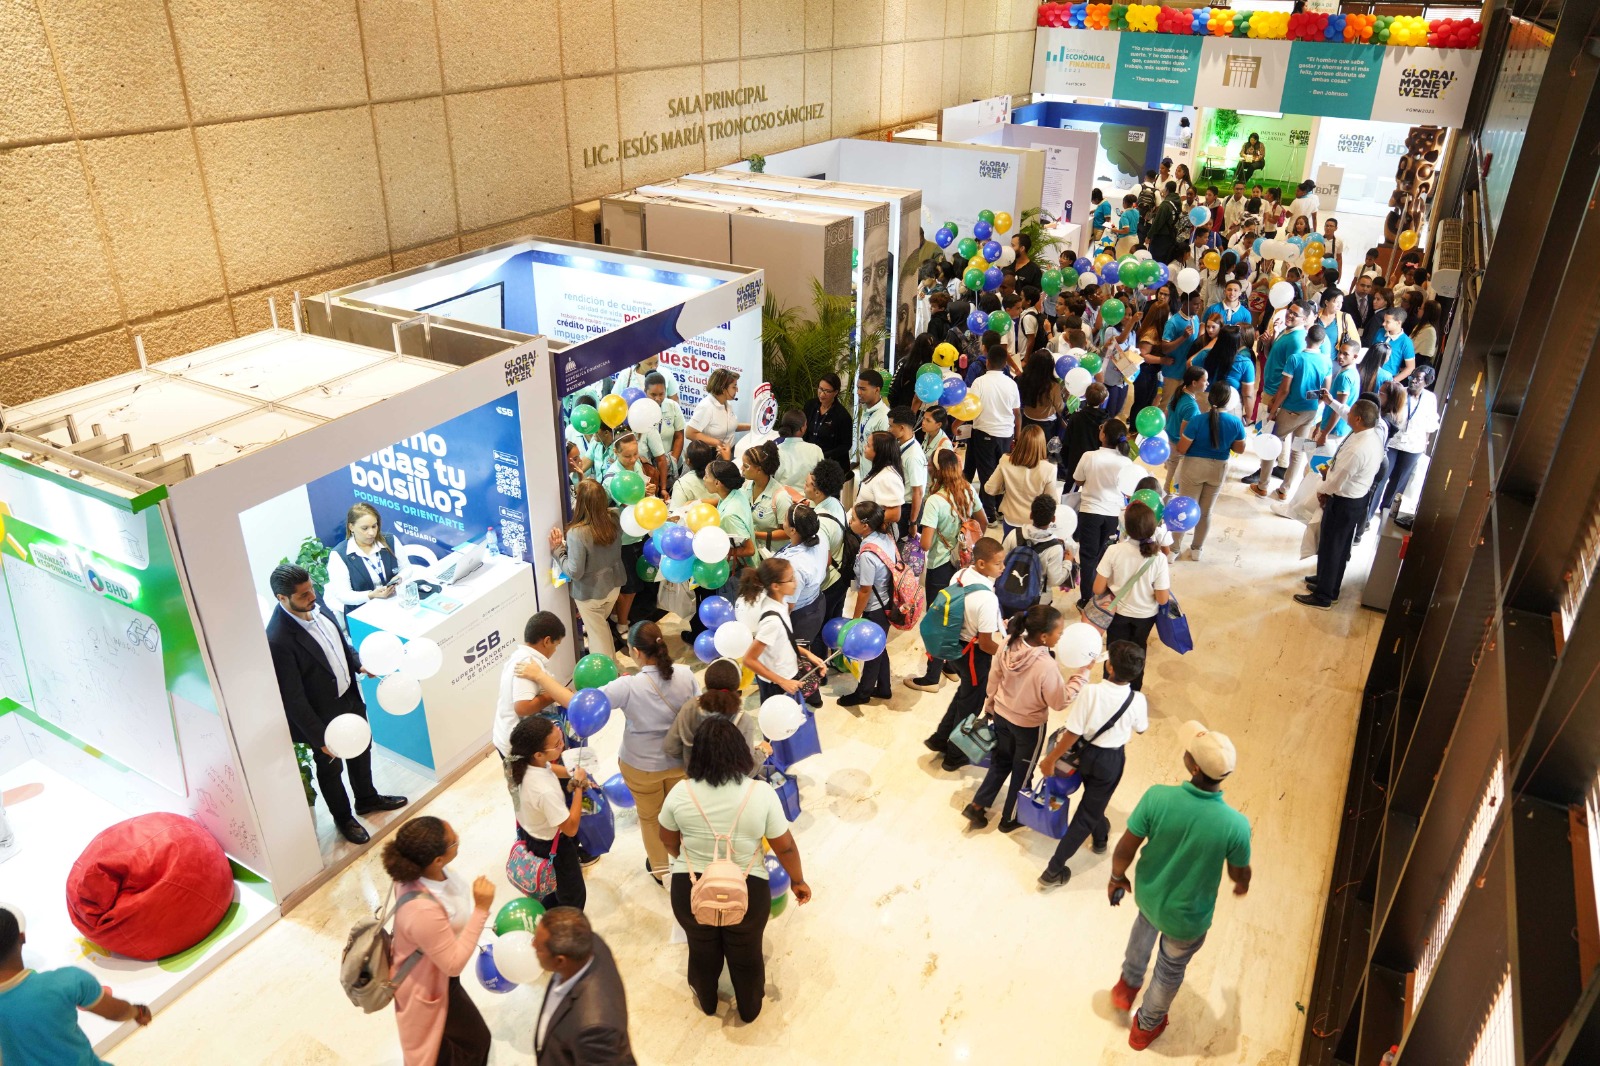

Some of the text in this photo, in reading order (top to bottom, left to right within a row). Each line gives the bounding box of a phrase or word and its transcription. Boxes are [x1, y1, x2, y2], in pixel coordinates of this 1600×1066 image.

[1066, 53, 1105, 61] ECONÓMICA
[1069, 61, 1111, 70] FINANCIERA
[1402, 68, 1457, 81] GLOBAL
[1400, 78, 1451, 90] MONEY
[1399, 87, 1440, 99] WEEK
[668, 85, 768, 118] SALA PRINCIPAL
[584, 103, 824, 168] LIC. JESÚS MARÍA TRONCOSO SÁNCHEZ
[1340, 134, 1376, 142] GLOBAL
[980, 160, 1010, 168] GLOBAL
[737, 279, 763, 296] GLOBAL
[564, 293, 605, 306] rendición
[607, 300, 618, 308] de
[737, 288, 760, 304] MONEY
[577, 304, 598, 313] calidad
[737, 297, 756, 312] WEEK
[557, 319, 584, 329] crédito
[505, 350, 537, 369] GLOBAL
[683, 346, 726, 360] eficiencia
[505, 359, 535, 378] MONEY
[712, 362, 743, 372] democracia
[506, 370, 532, 387] WEEK
[680, 384, 700, 395] ética
[434, 458, 466, 490] tu
[350, 461, 467, 517] bolsillo?
[353, 489, 465, 531] PODEMOS ORIENTARTE
[403, 523, 418, 532] PRO
[404, 529, 437, 543] USUARIO
[34, 550, 64, 567] FINANZAS
[38, 558, 82, 583] RESPONSABLES
[105, 581, 129, 599] BHD
[476, 630, 500, 658] SB
[451, 637, 516, 685] SUPERINTENDENCIA
[468, 653, 503, 681] DE BANCOS
